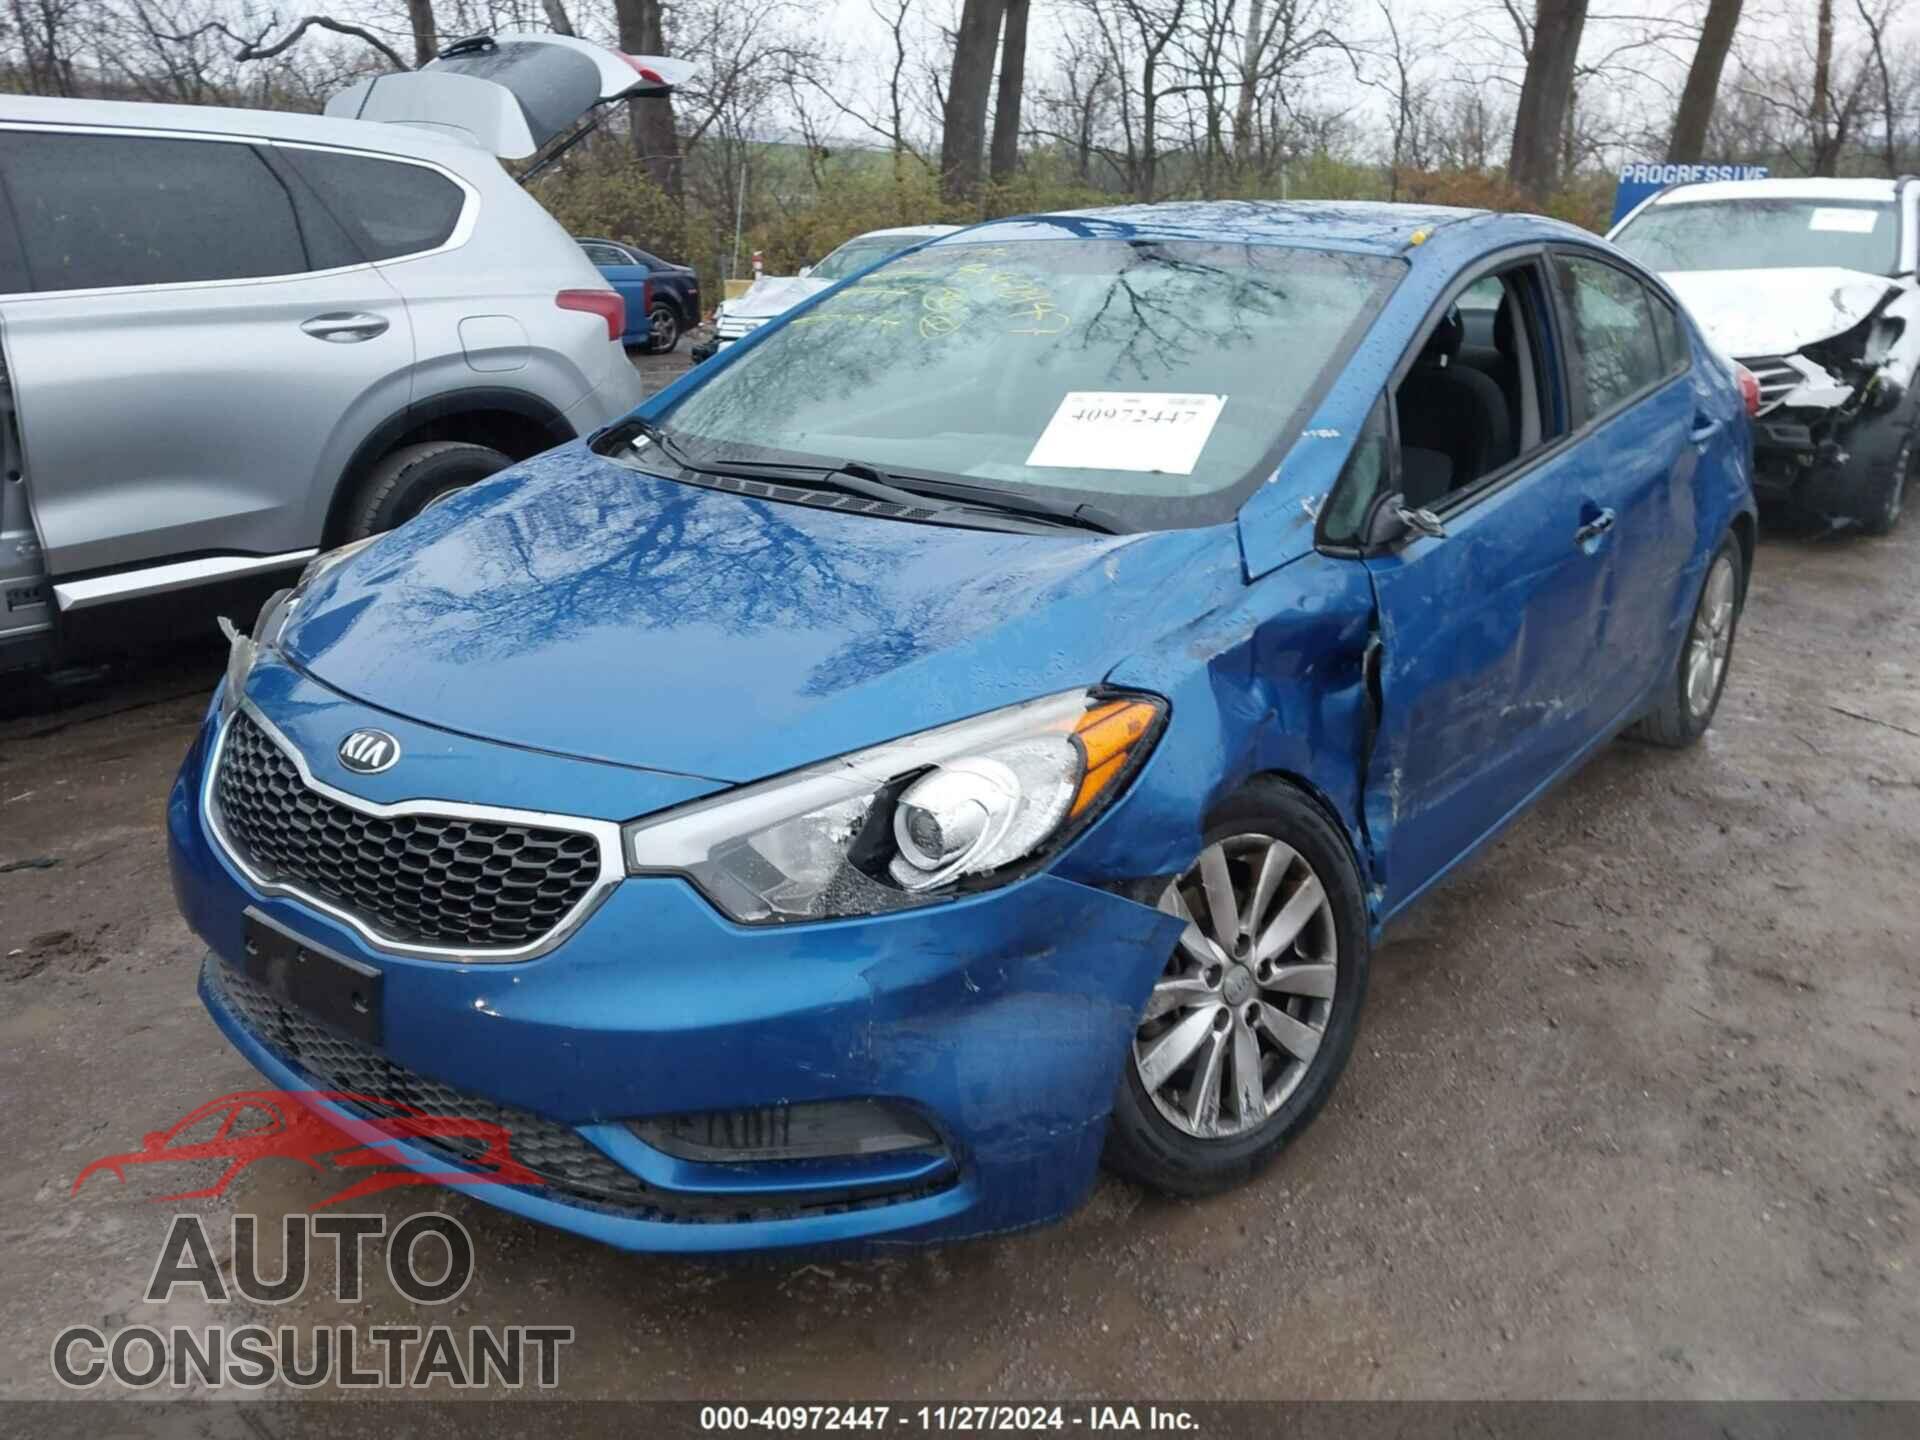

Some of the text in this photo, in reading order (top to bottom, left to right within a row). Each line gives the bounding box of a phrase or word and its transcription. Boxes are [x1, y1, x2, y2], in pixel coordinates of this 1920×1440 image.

[1619, 164, 1768, 184] PROGRESSIVE
[1071, 407, 1198, 424] 40972447
[340, 732, 388, 768] KIA
